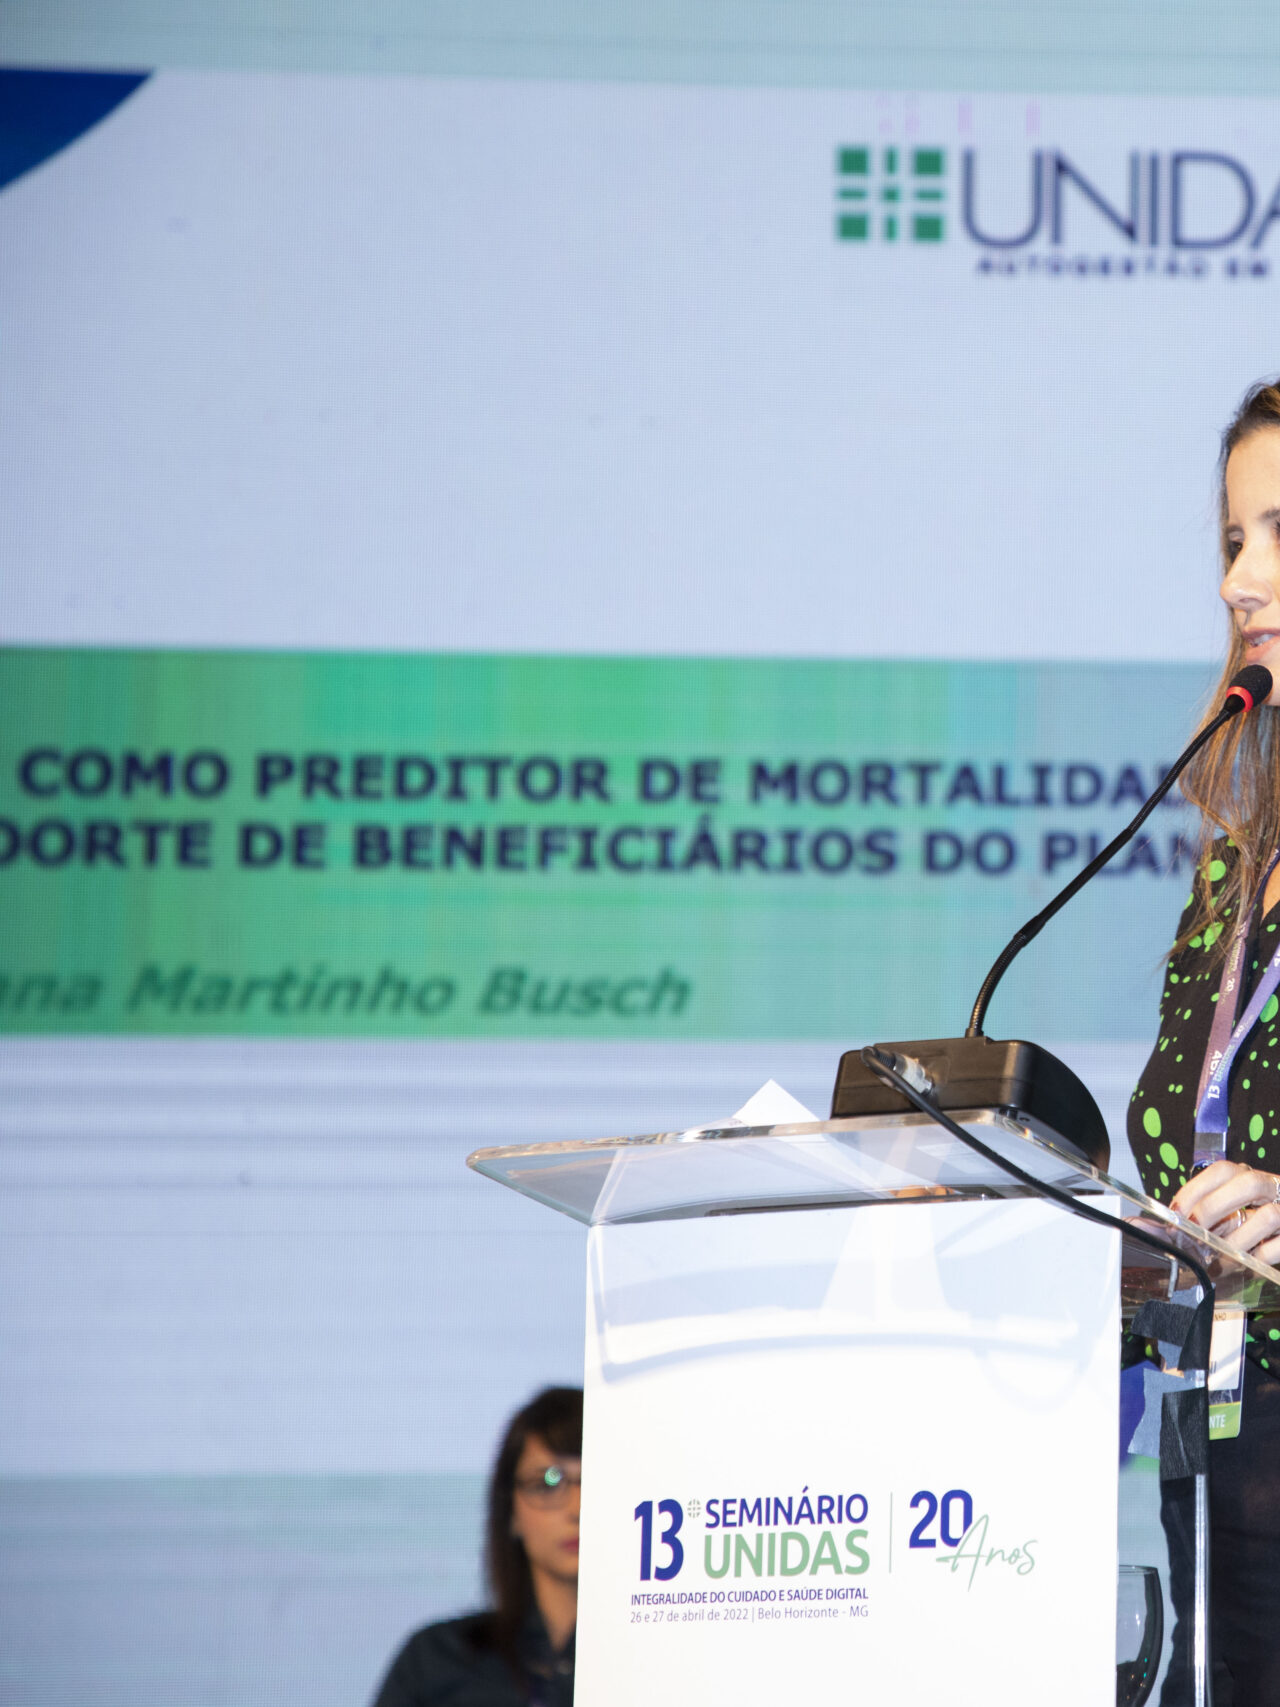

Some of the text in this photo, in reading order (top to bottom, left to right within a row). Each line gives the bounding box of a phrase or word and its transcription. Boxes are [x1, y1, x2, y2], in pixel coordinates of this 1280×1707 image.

[17, 746, 232, 801] COMO
[255, 752, 611, 805] PREDITOR
[637, 757, 723, 805] DE
[236, 820, 327, 870] DE
[353, 813, 898, 875] BENEFICIÁRIOS
[921, 829, 1018, 877] DO
[125, 962, 458, 1018] Martinho
[477, 964, 693, 1018] Busch
[1207, 1084, 1221, 1099] 13
[705, 1486, 869, 1528] SEMINÁRIO
[909, 1489, 973, 1548] 20
[704, 1529, 870, 1579] UNIDAS
[935, 1514, 1038, 1592] Anos
[630, 1611, 641, 1623] 26
[644, 1613, 650, 1622] e
[652, 1610, 664, 1622] 27
[667, 1610, 679, 1621] de
[682, 1609, 704, 1621] abril
[707, 1609, 720, 1621] de
[723, 1608, 749, 1621] 2022
[758, 1607, 781, 1620] Belo
[784, 1606, 839, 1619] Horizonte
[849, 1605, 869, 1618] MG
[631, 1586, 869, 1606] INTEGRALIDADE DO CUIDADO E SAÚDE DIGITAL
